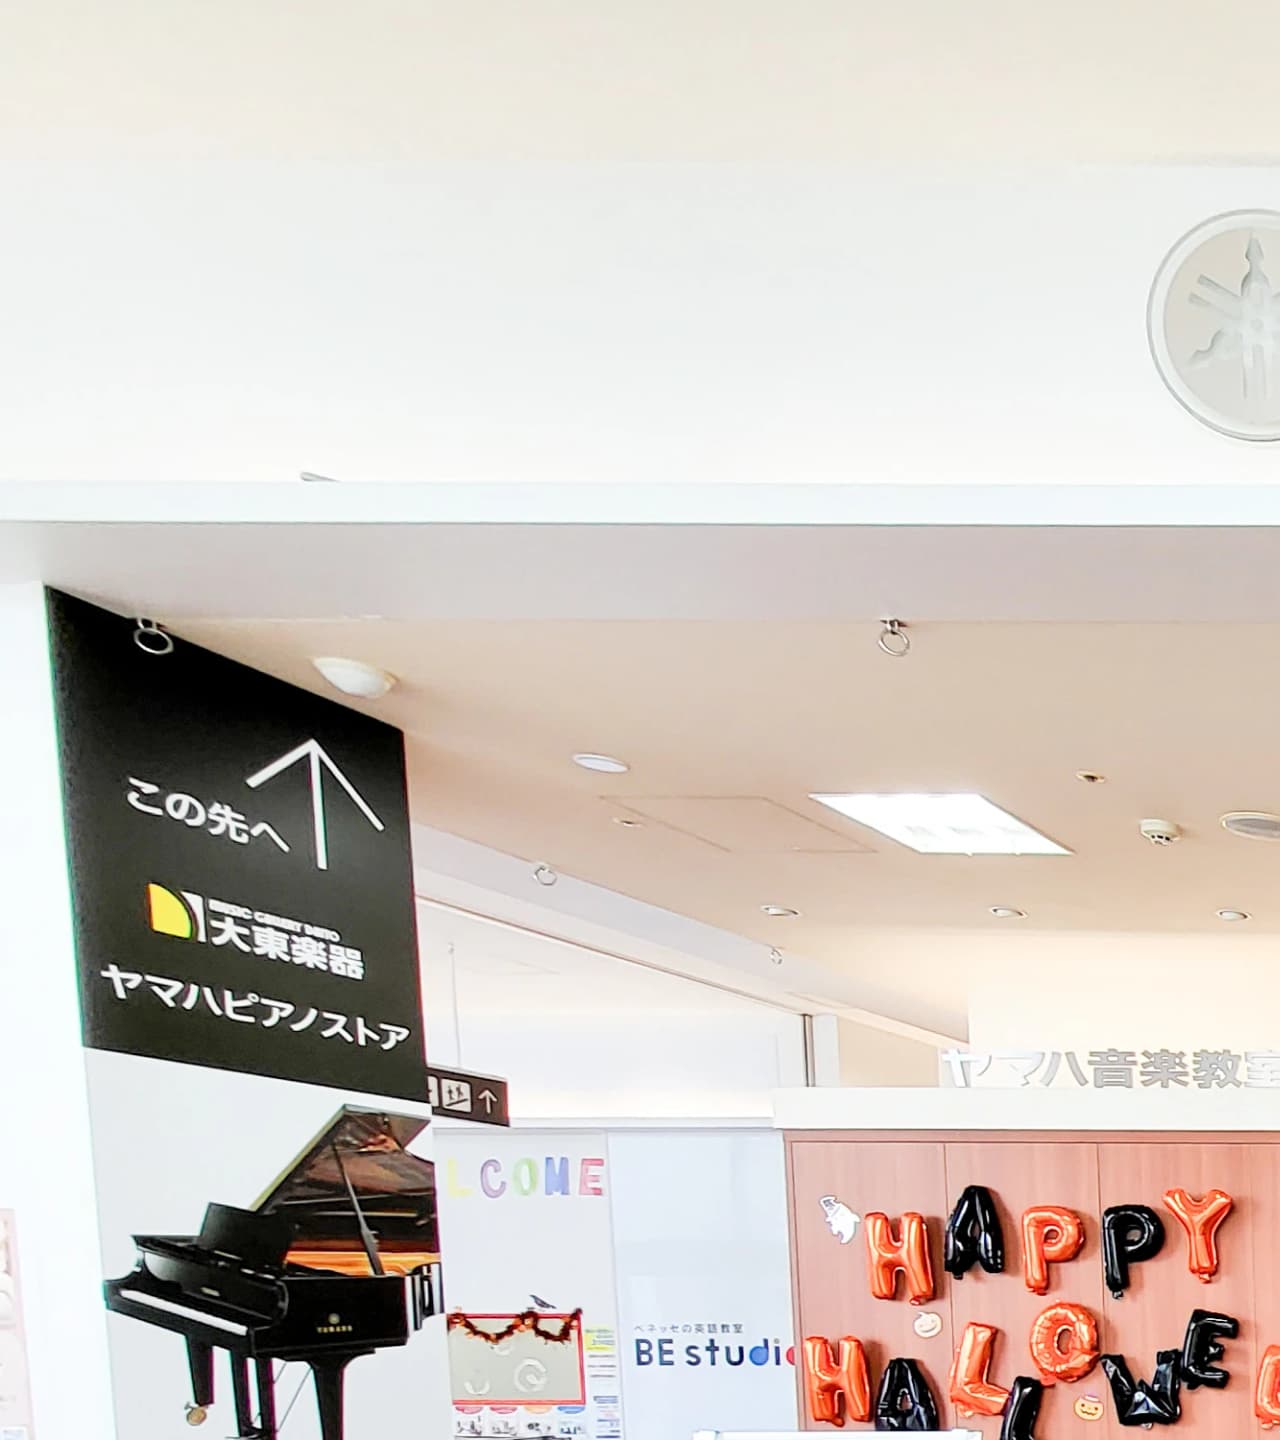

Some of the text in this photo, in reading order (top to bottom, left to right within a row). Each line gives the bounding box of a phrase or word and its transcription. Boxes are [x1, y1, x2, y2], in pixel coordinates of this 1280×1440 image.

[127, 776, 290, 852] この先へ
[210, 916, 364, 981] 大東楽器
[101, 963, 411, 1051] ヤマハピアノストア
[865, 1185, 1234, 1304] HAPPY
[633, 1322, 744, 1335] ベネッセの英語教室
[636, 1338, 675, 1366] BE
